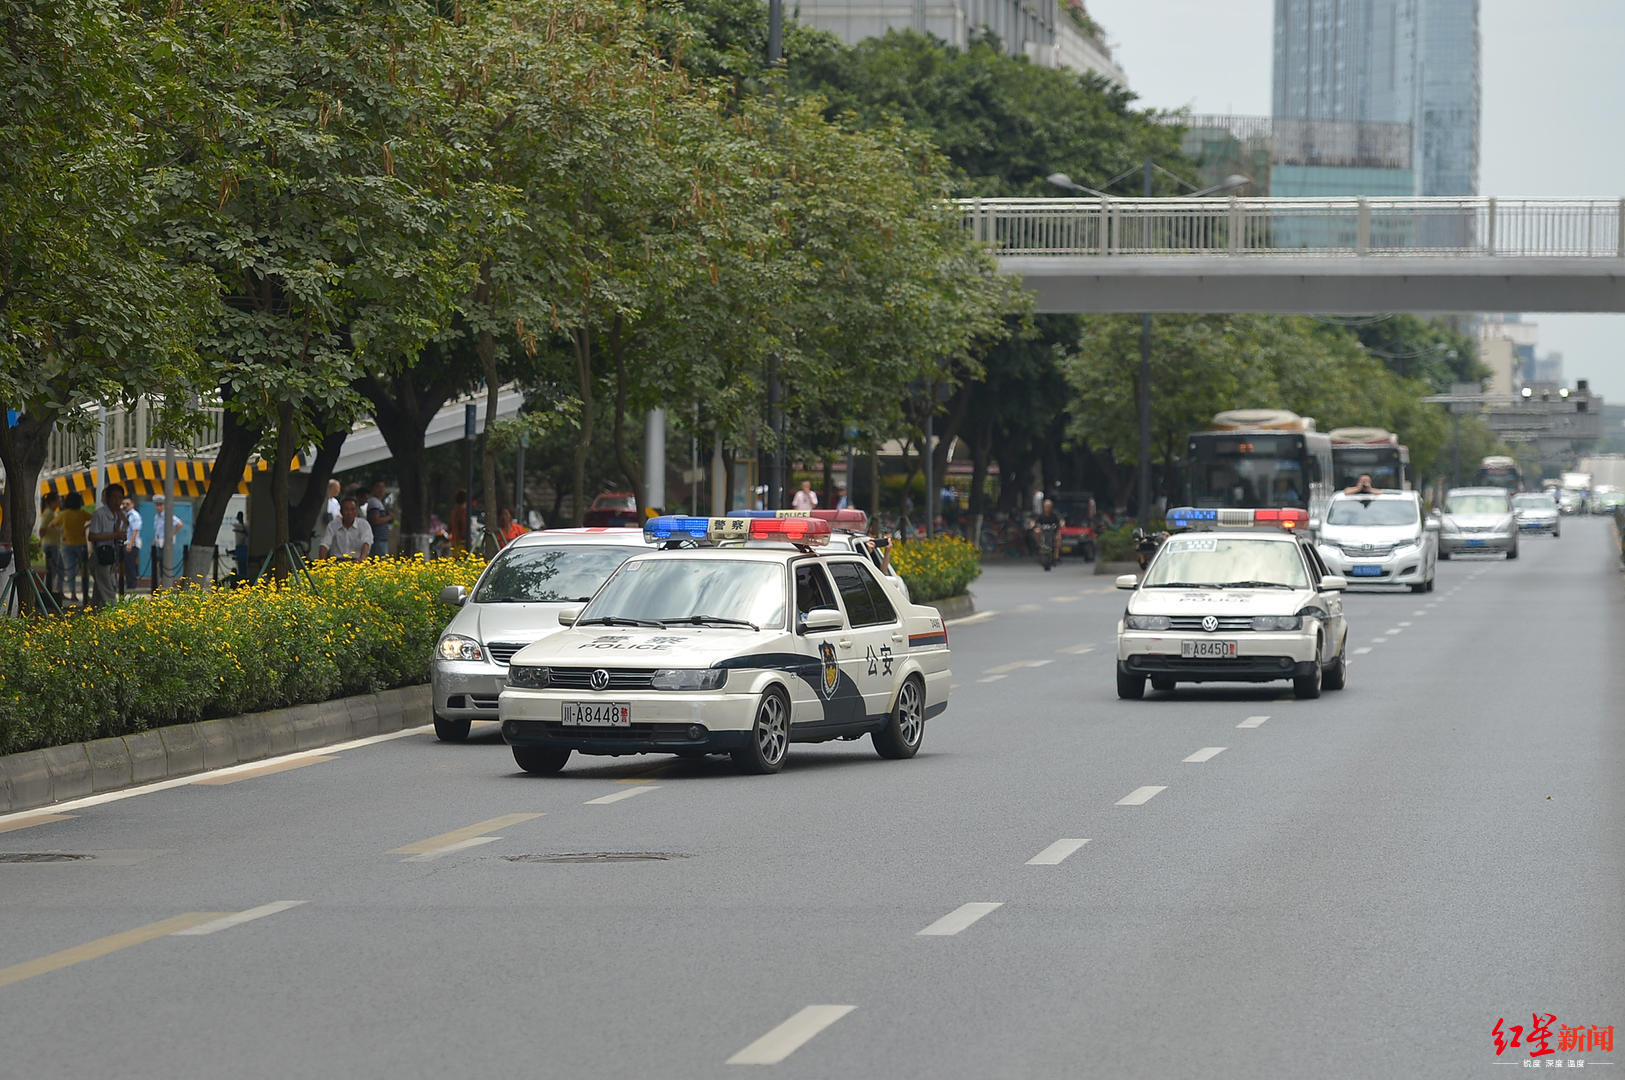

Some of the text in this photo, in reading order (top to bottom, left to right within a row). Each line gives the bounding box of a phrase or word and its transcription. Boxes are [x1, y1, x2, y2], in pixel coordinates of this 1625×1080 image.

[714, 519, 744, 531] 警察
[577, 643, 672, 651] POLICE
[866, 643, 894, 677] 公安
